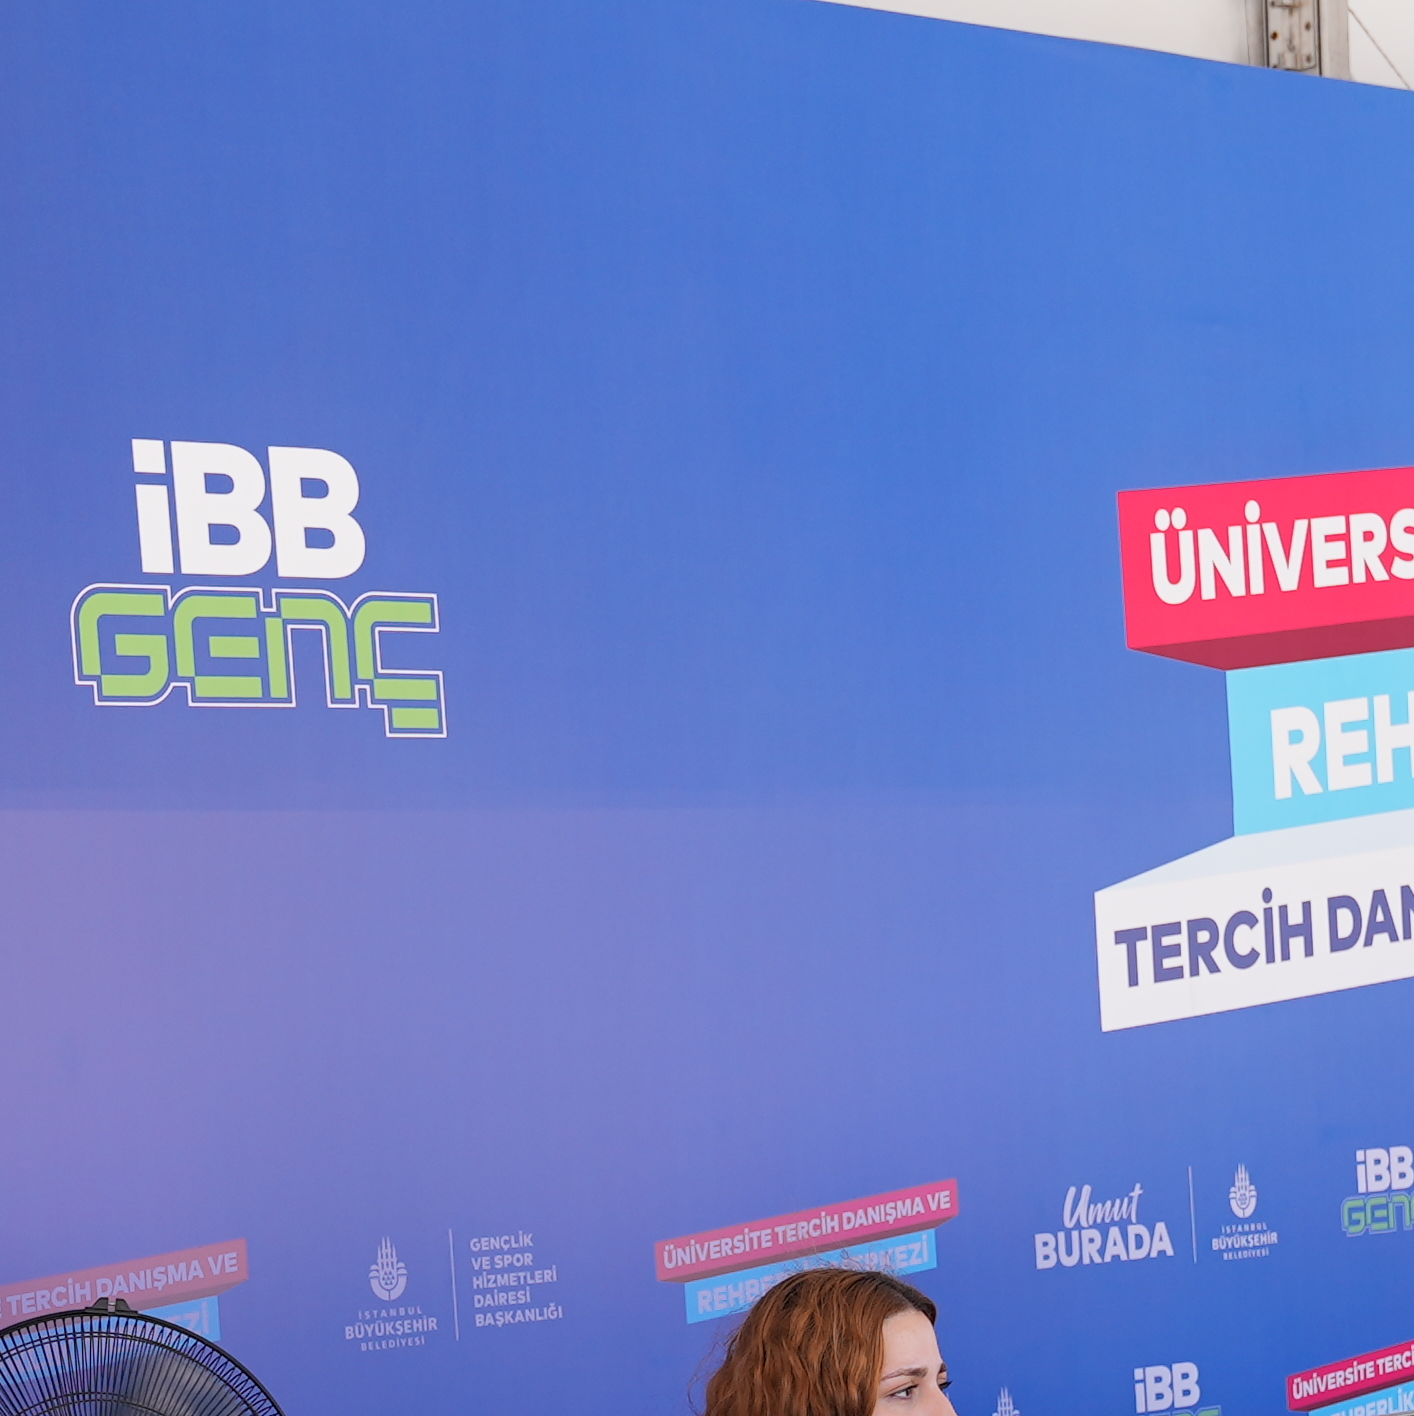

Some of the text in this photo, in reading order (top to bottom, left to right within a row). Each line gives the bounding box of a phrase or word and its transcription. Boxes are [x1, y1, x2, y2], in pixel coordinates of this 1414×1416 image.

[1113, 887, 1316, 989] TERCİH
[1062, 1182, 1145, 1230] Umut
[469, 1230, 534, 1253] GENÇLİK
[662, 1190, 952, 1270] ÜNİVERSİTE TERCİH DANIŞMA VE
[1211, 1230, 1279, 1251] BÜYÜKŞEHİR
[1033, 1221, 1175, 1271] BURADA
[471, 1252, 534, 1271] VE SPOR
[6, 1278, 92, 1318] TERCİH
[95, 1262, 205, 1300] DANIŞMA
[207, 1252, 239, 1275] VE
[472, 1264, 558, 1290] HİZMETLERİ
[473, 1286, 532, 1308] DAİRESİ
[357, 1305, 423, 1320] İSTANBUL
[475, 1302, 564, 1329] BAŞKANLIĞI
[344, 1314, 439, 1341] BÜYÜKŞEHİR
[360, 1335, 426, 1352] BELEDİYESİ
[1292, 1363, 1376, 1400] ÜNİVERSİTE
